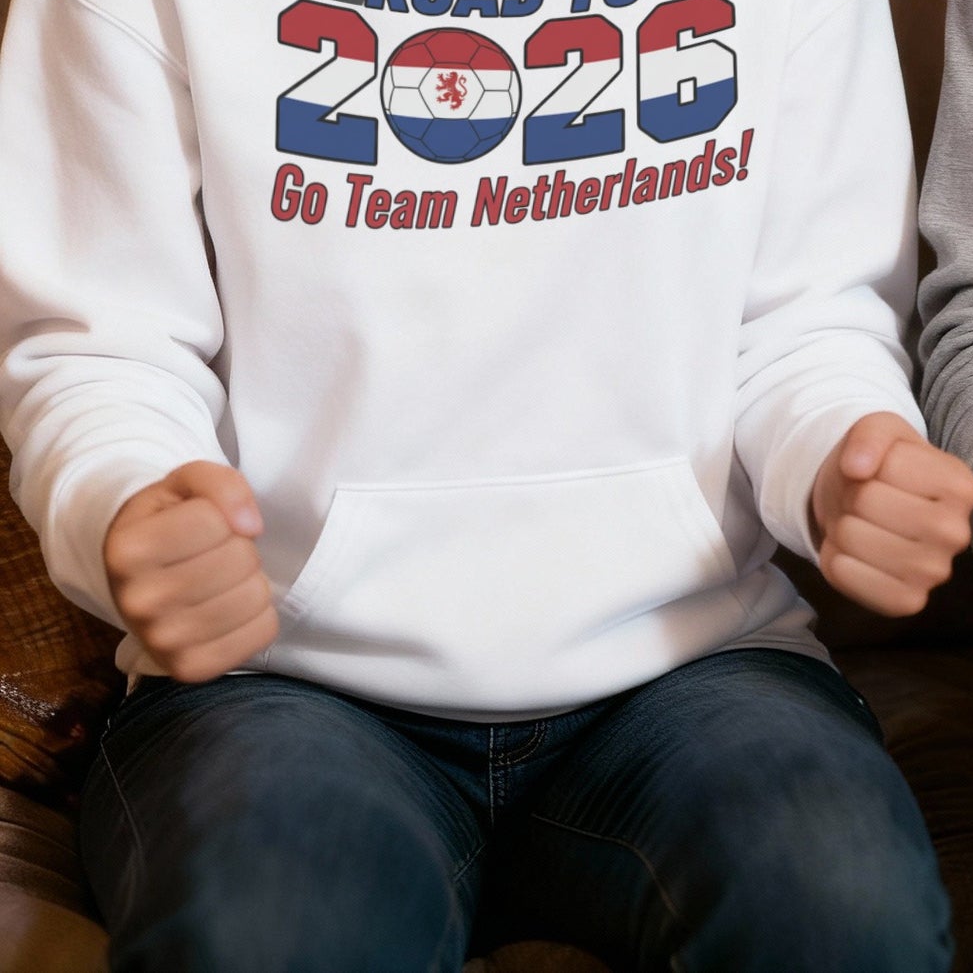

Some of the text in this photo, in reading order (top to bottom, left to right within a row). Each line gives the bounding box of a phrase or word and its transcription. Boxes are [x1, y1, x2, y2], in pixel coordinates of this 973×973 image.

[271, 128, 755, 229] Go Team Netherlands!
